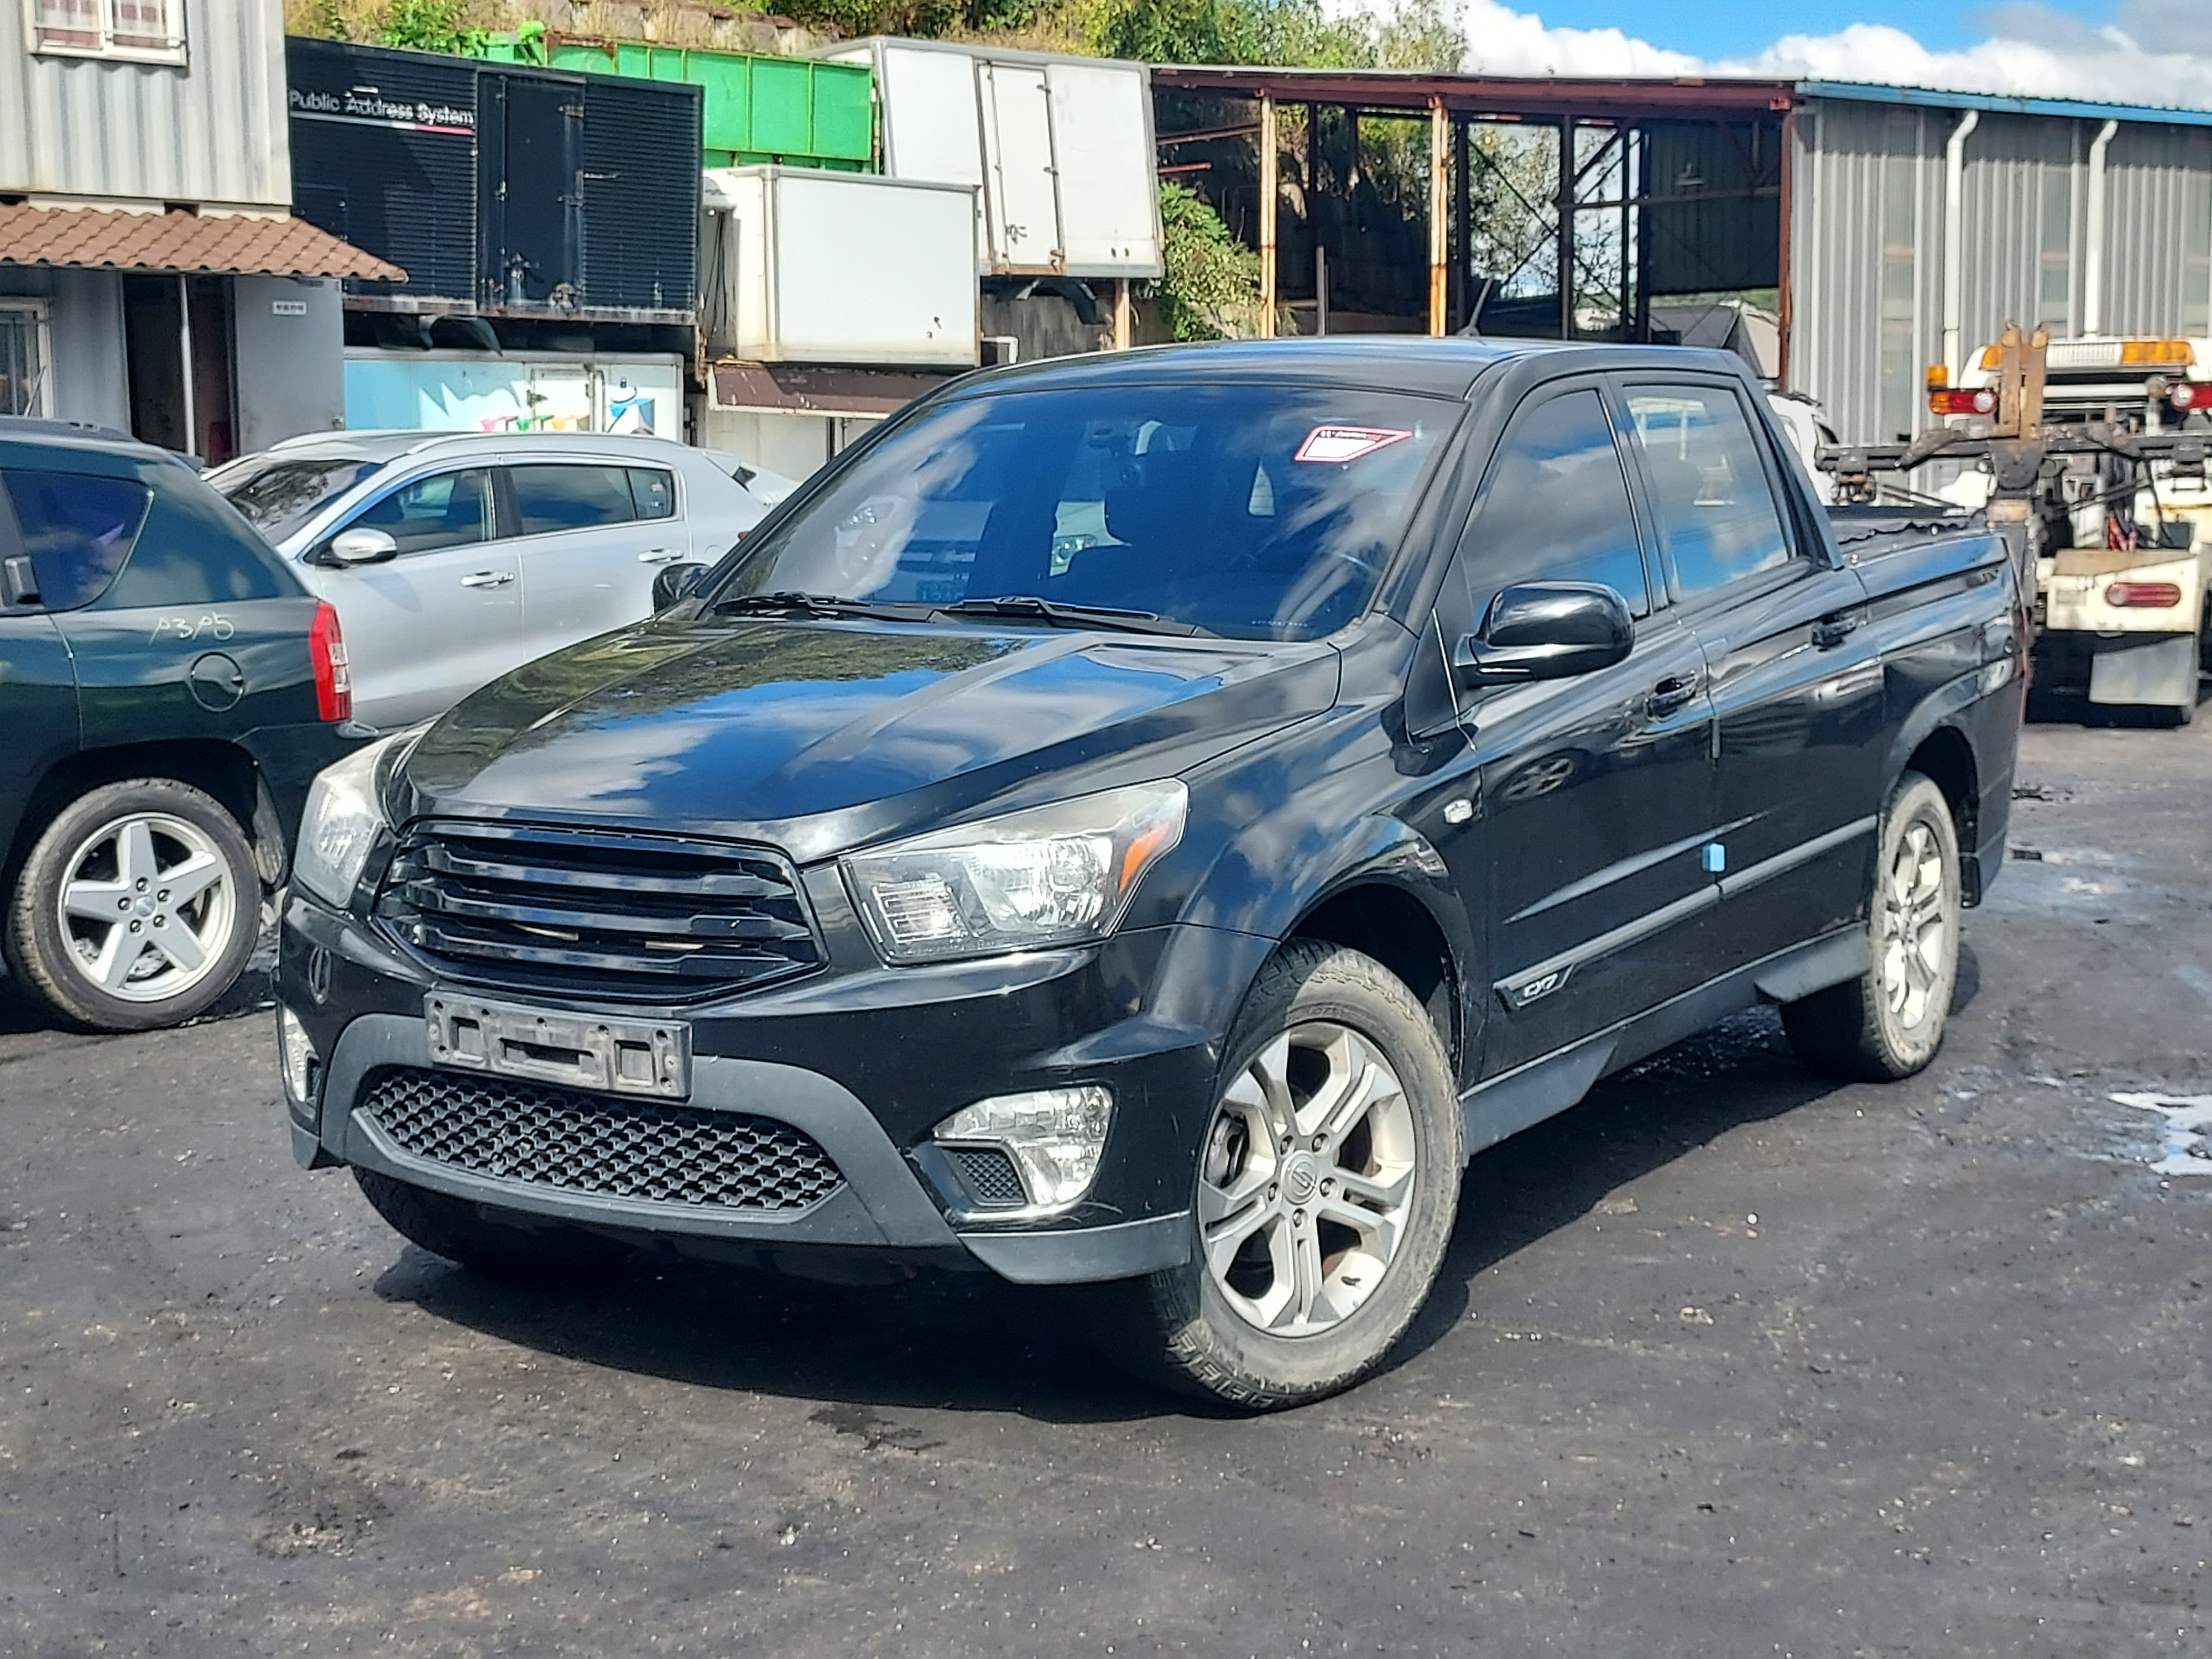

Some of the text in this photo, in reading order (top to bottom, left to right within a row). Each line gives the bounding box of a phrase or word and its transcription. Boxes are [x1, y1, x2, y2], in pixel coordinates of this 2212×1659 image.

[289, 88, 474, 126] Public Address System
